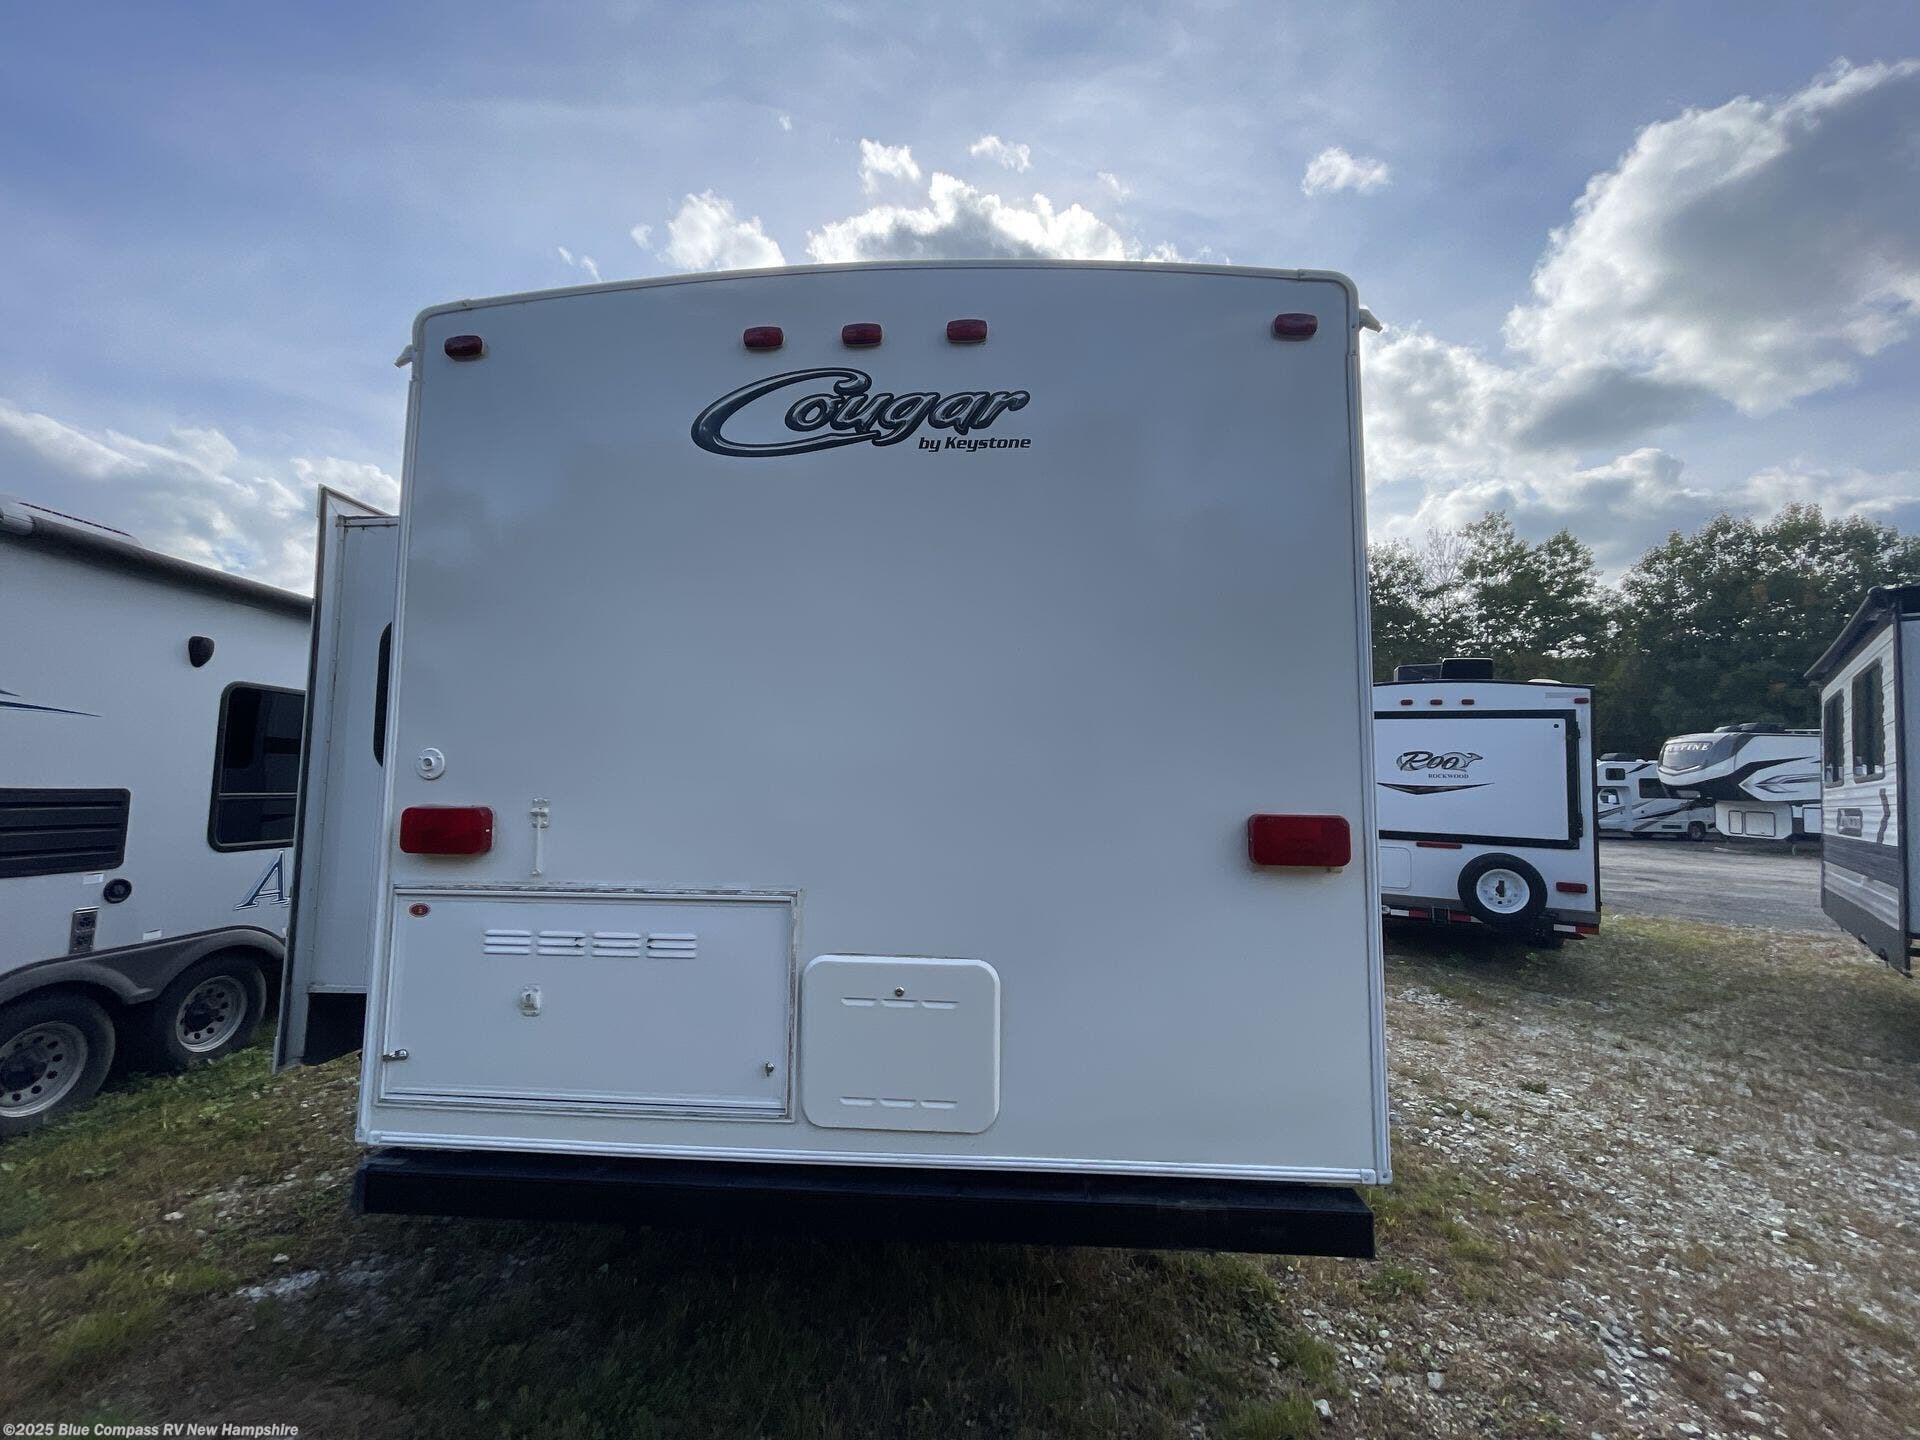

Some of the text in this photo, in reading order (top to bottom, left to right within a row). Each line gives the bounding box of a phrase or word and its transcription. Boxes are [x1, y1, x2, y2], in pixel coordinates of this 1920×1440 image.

[690, 367, 1031, 457] Cougar
[918, 436, 1031, 452] by Keystone
[1399, 751, 1460, 771] Roo
